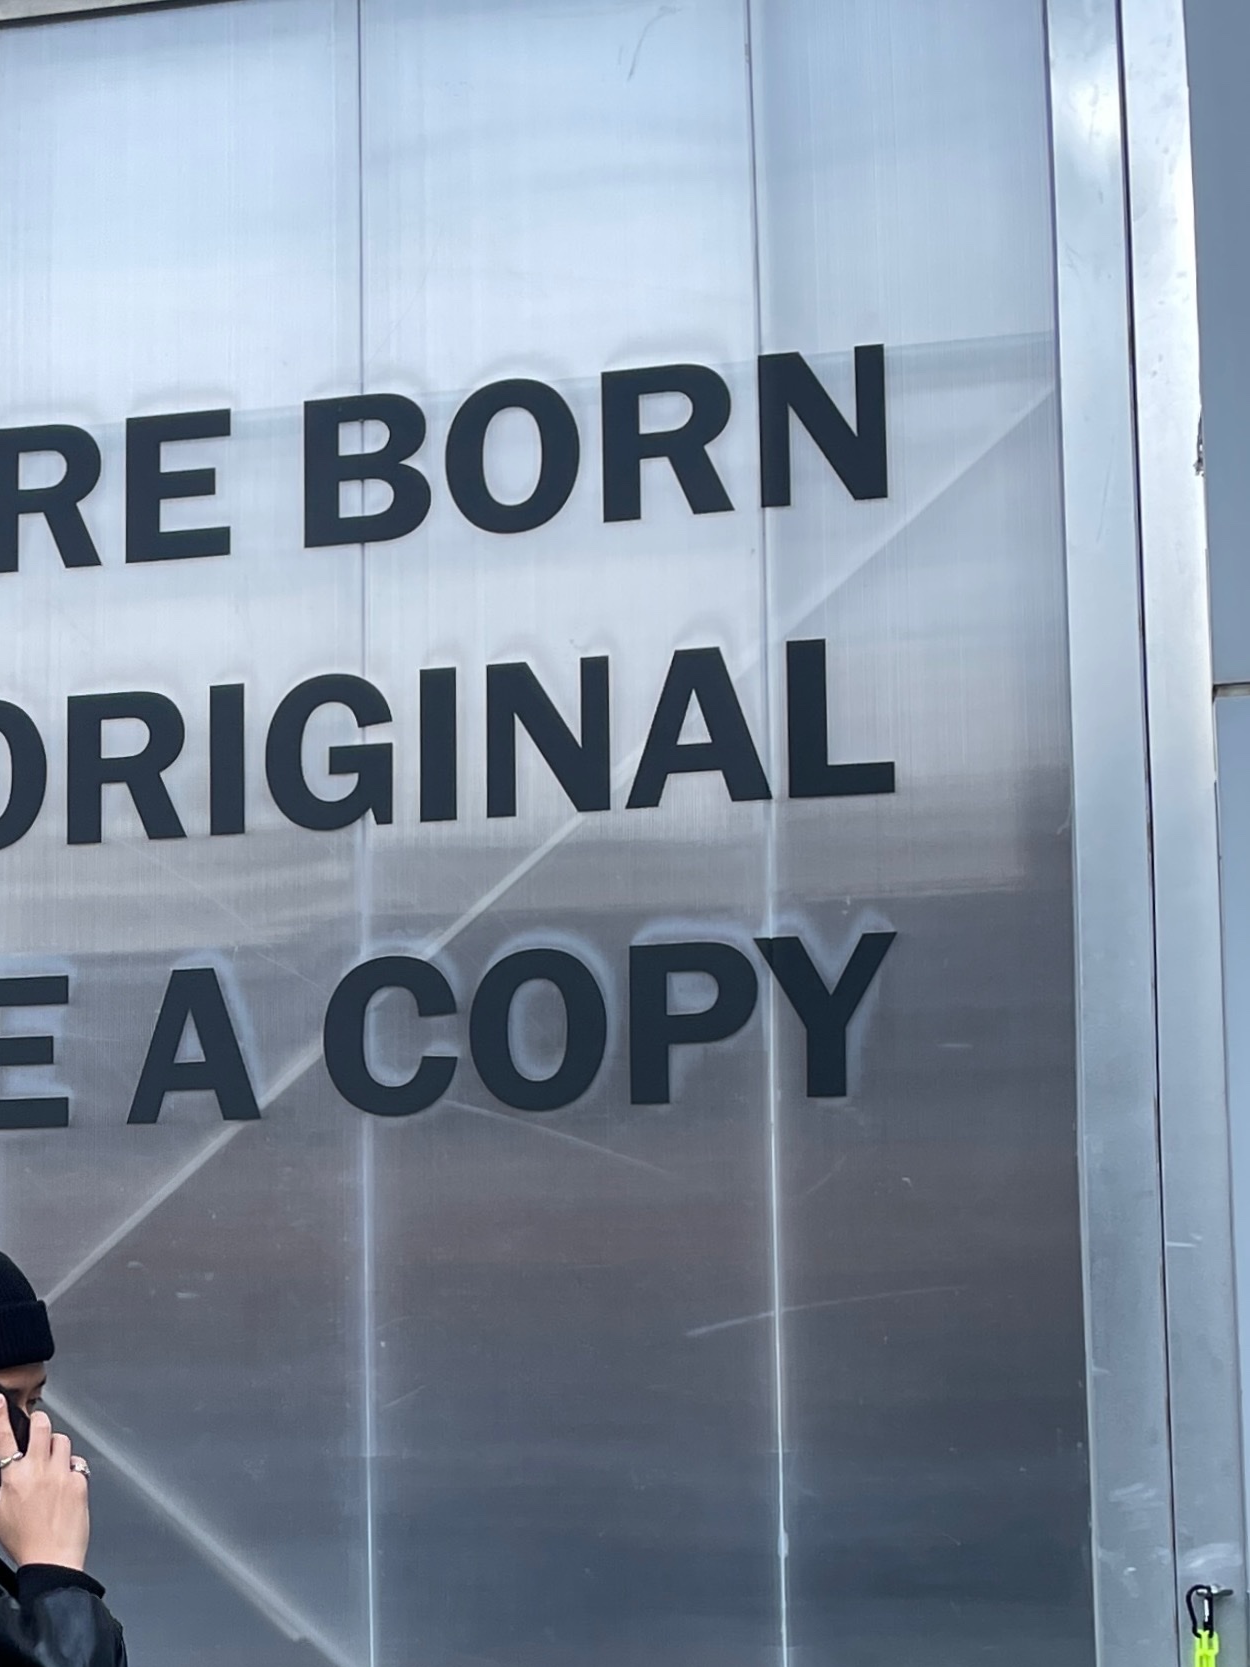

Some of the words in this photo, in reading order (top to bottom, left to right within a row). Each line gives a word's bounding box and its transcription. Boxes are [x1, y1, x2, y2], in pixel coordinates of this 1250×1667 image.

[304, 344, 888, 548] BORN
[126, 967, 262, 1125] A
[323, 931, 899, 1118] COPY
